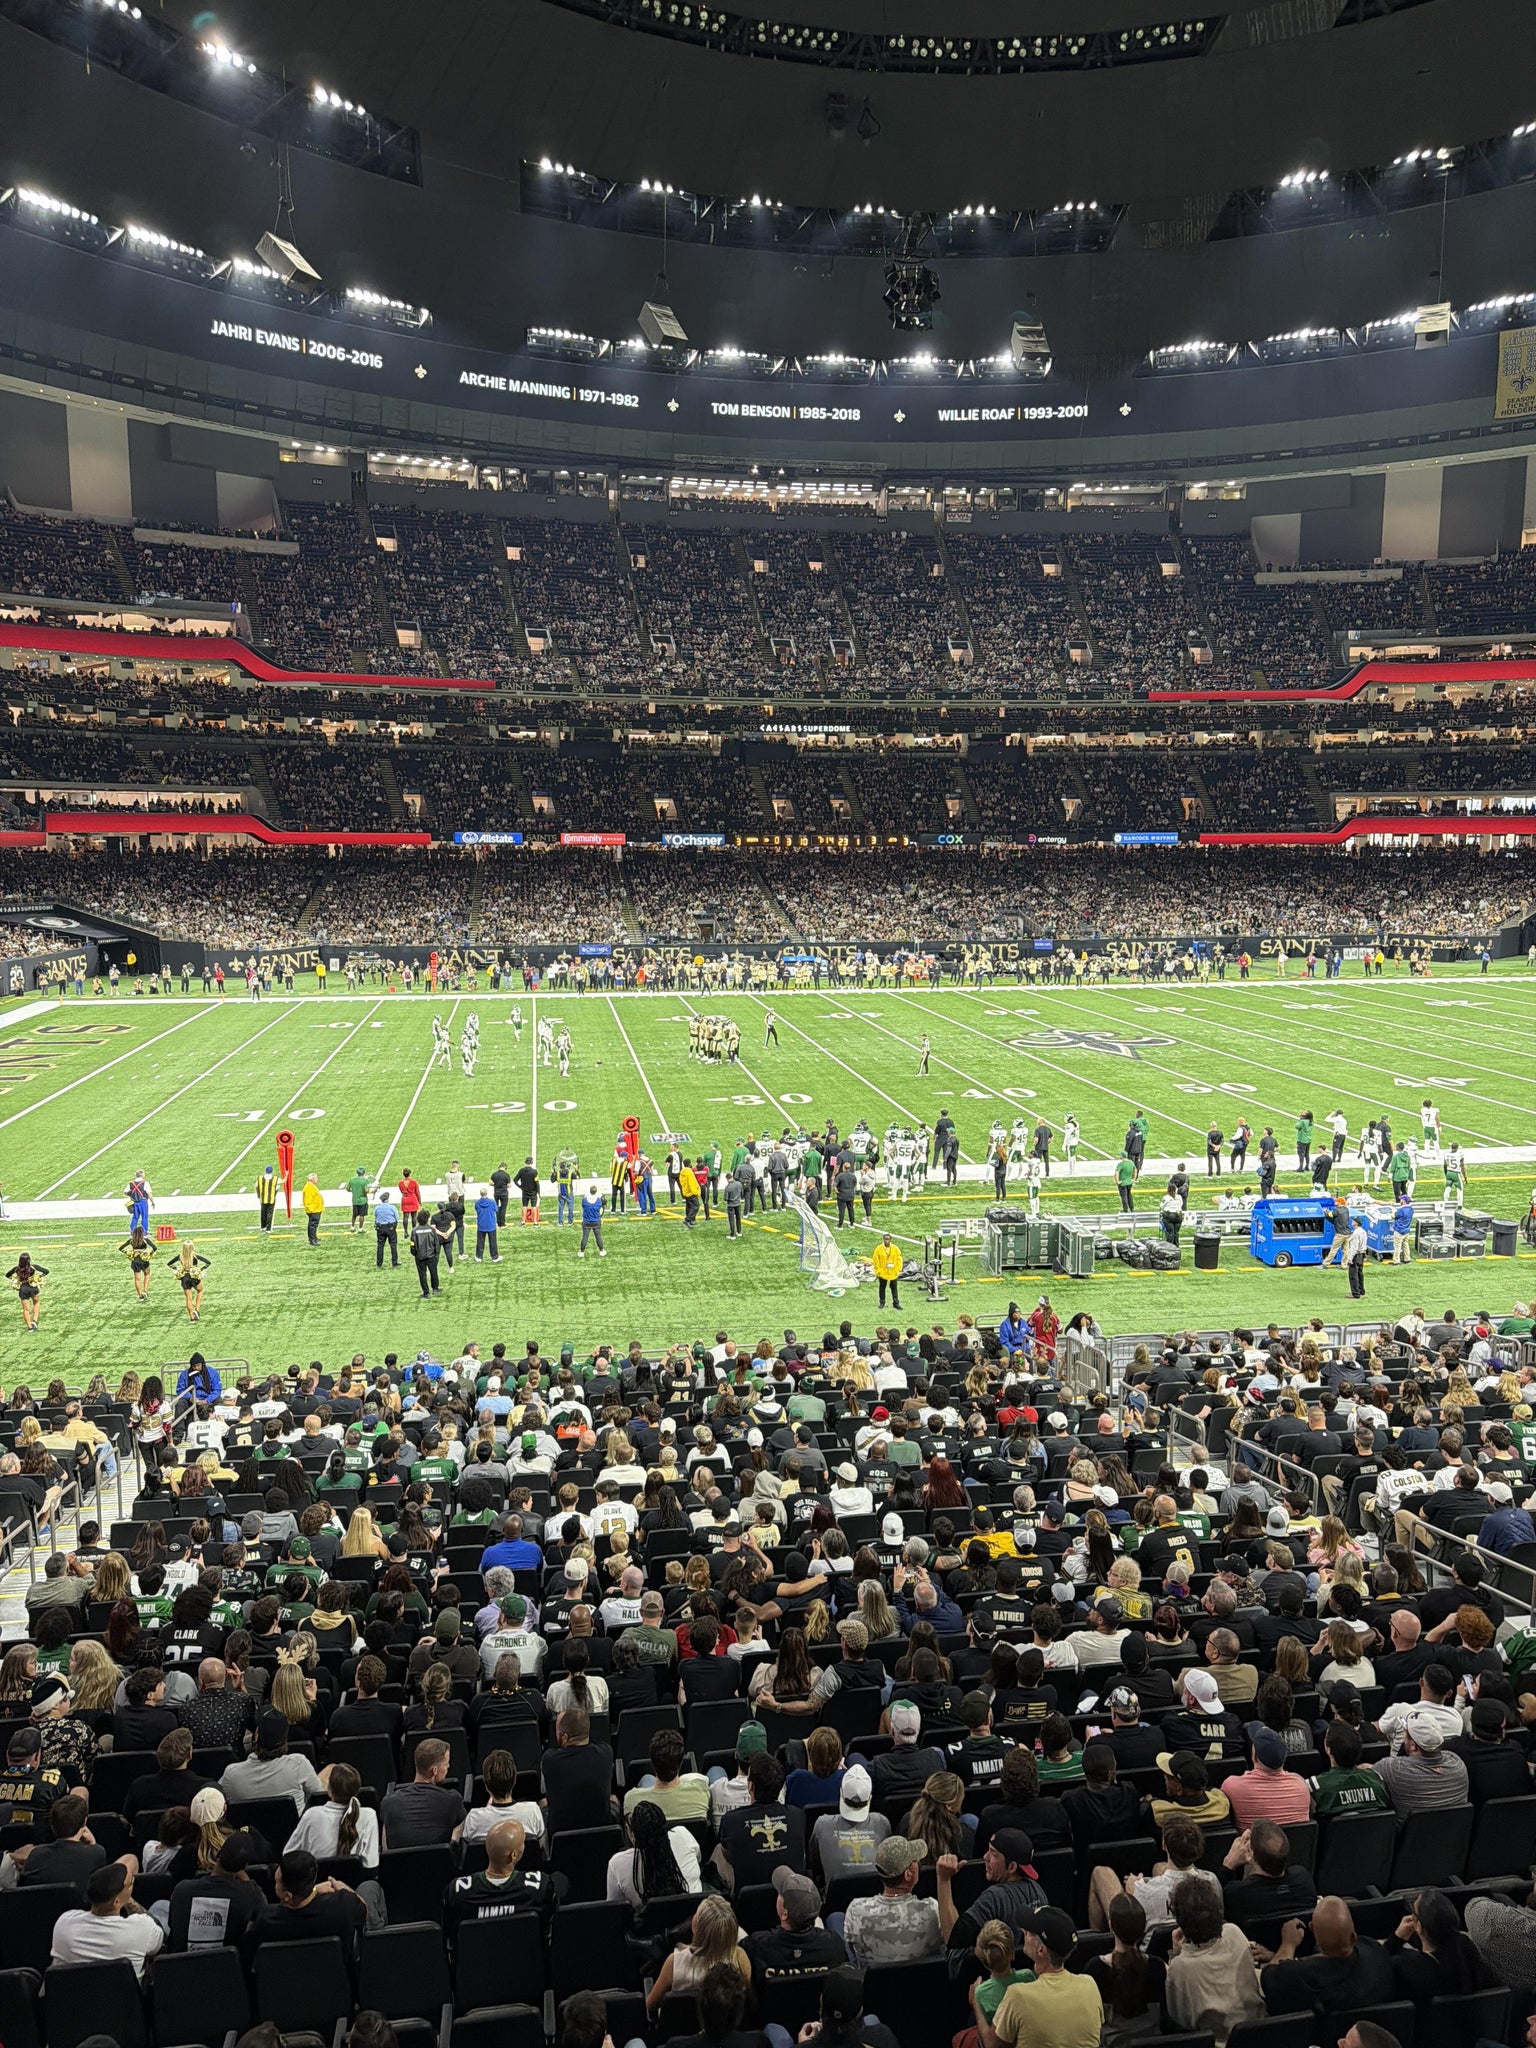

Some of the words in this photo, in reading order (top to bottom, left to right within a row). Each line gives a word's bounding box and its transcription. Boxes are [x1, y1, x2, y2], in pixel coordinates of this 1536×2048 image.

[210, 319, 252, 341] JAHRI
[255, 328, 300, 351] EVANS
[308, 340, 383, 369] 2006-2016
[459, 371, 507, 390] ARCHIE
[508, 379, 571, 399] MANNING
[579, 388, 639, 408] 1971-1982
[1507, 395, 1536, 404] SEASON
[1507, 401, 1535, 409] TICKET
[711, 402, 739, 415] TOM
[741, 404, 791, 418] BENSON
[799, 407, 861, 421] 1985-2018
[938, 409, 980, 421] WILLIE
[981, 408, 1016, 421] ROAF
[1023, 405, 1089, 420] 1993-2001
[501, 682, 534, 691] SAINTS
[572, 685, 604, 693] SAINTS
[641, 687, 672, 695] SAINTS
[708, 688, 738, 696] SAINTS
[23, 692, 56, 703] SAINTS
[773, 691, 804, 699] SAINTS
[840, 692, 870, 700] SAINTS
[905, 692, 935, 700] SAINTS
[971, 692, 1001, 700] SAINTS
[1037, 692, 1067, 700] SAINTS
[1103, 692, 1133, 700] SAINTS
[95, 698, 128, 708] SAINTS
[169, 703, 203, 713] SAINTS
[247, 707, 281, 717] SAINTS
[321, 711, 354, 719] SAINTS
[396, 714, 429, 722] SAINTS
[467, 717, 497, 725] SAINTS
[537, 719, 567, 727] SAINTS
[603, 721, 633, 729] SAINTS
[667, 723, 695, 731] SAINTS
[760, 724, 802, 732] CAESARS
[478, 834, 516, 843] Allstate
[564, 833, 603, 843] Community
[672, 835, 723, 846] Ochsner
[937, 834, 964, 844] COX
[1037, 835, 1067, 845] entergy
[946, 942, 1020, 959] SAINTS
[1106, 940, 1177, 956] SAINTS
[1260, 937, 1330, 955] SAINTS
[612, 946, 692, 962] SAINTS
[783, 945, 857, 960] SAINTS
[259, 950, 321, 971] SAINTS
[960, 1087, 1037, 1099] 40
[1172, 1082, 1258, 1094] 50
[730, 1093, 813, 1105] 30
[491, 1100, 578, 1113] 20
[236, 1108, 326, 1122] 10
[760, 1147, 774, 1158] 99
[785, 1148, 798, 1159] 78
[898, 1146, 912, 1157] 55
[526, 1208, 532, 1221] 2
[160, 1227, 171, 1239] 10
[196, 1433, 209, 1448] 5
[1393, 1475, 1424, 1488] COLSTON
[604, 1507, 623, 1516] OLAVE
[601, 1518, 627, 1534] 12
[622, 1609, 641, 1619] HALL
[993, 1610, 1025, 1622] MATHIEU
[173, 1629, 200, 1640] CLARK
[494, 1637, 528, 1648] GARDNER
[35, 1660, 61, 1673] CLARK
[1200, 1723, 1227, 1738] CARR
[478, 1905, 515, 1919] NAMATH
